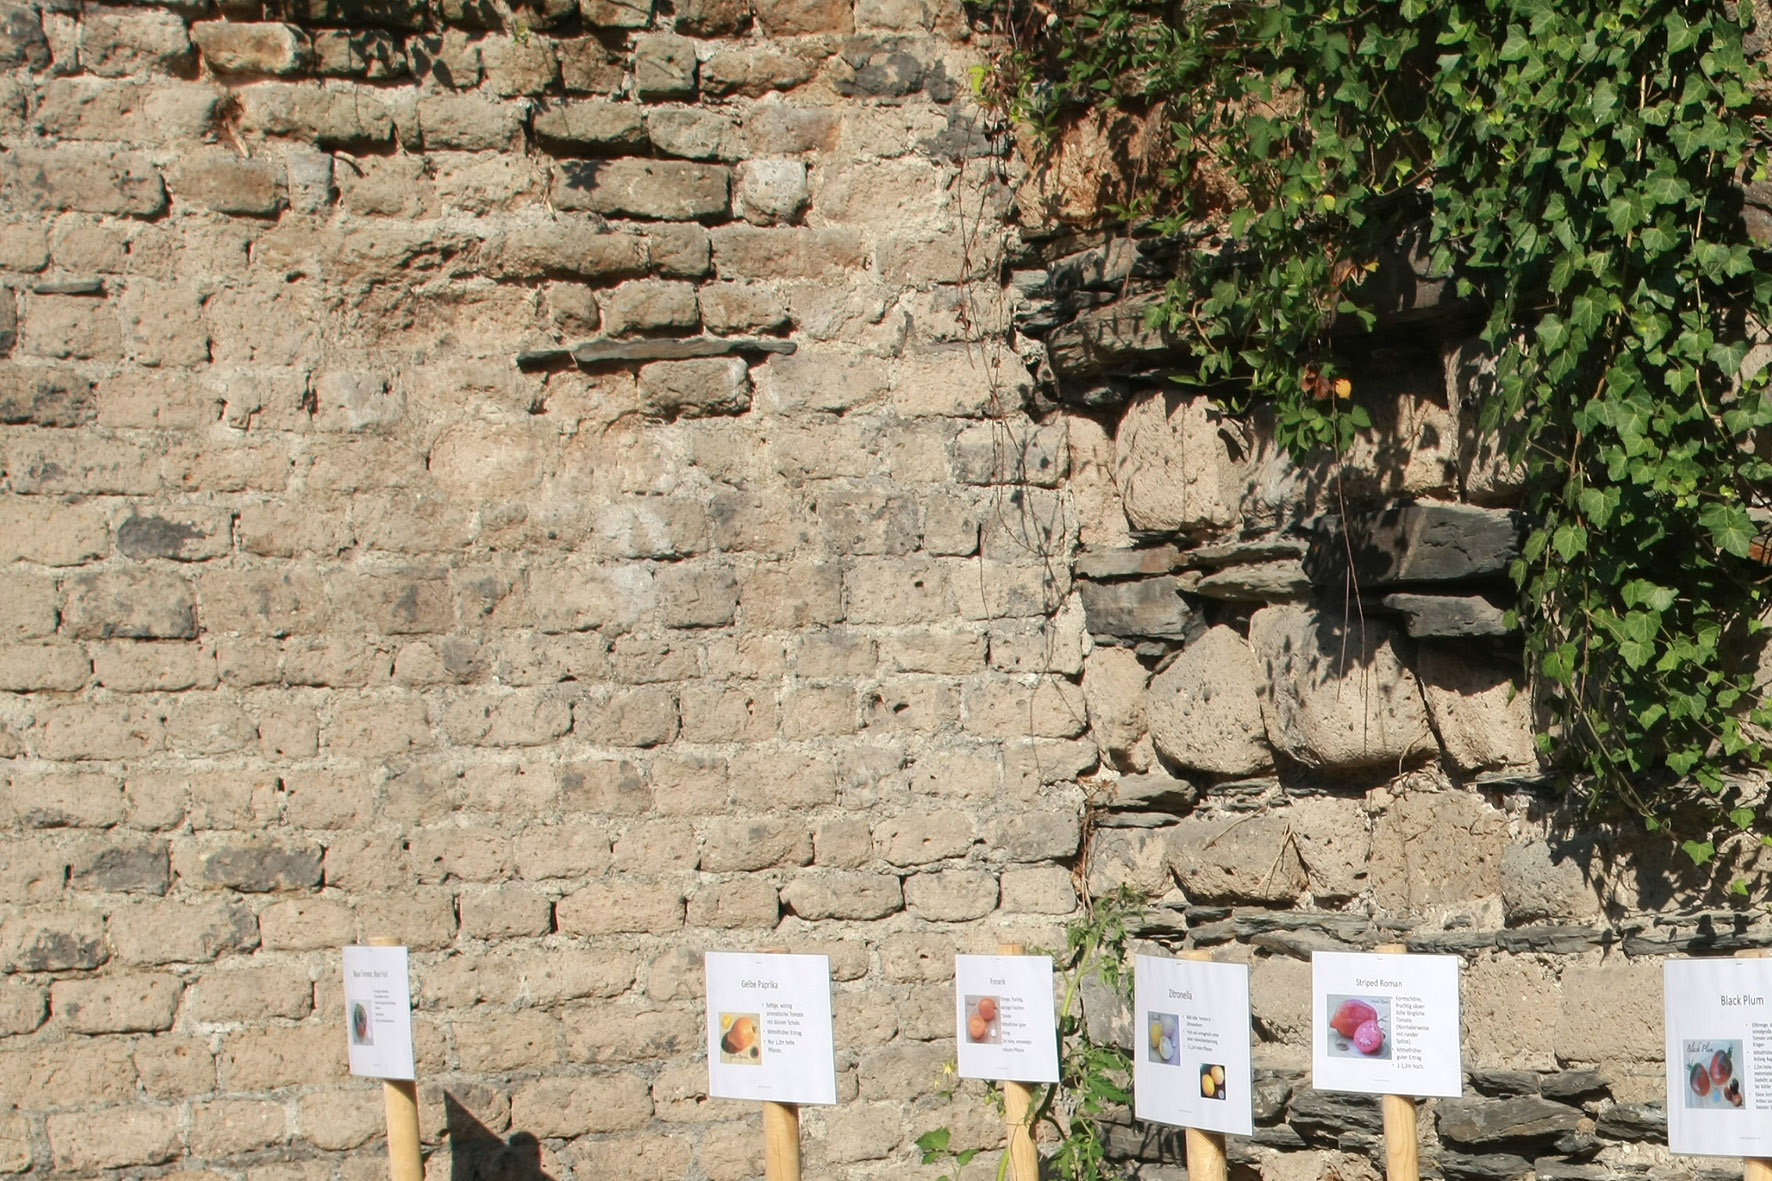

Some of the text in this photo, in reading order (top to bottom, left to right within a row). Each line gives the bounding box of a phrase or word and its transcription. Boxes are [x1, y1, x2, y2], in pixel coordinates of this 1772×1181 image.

[741, 980, 778, 990] Gelbe Paprika
[1356, 978, 1403, 988] Striped Roman
[1169, 988, 1192, 1001] Zitronella
[1721, 994, 1764, 1006] Black Plum
